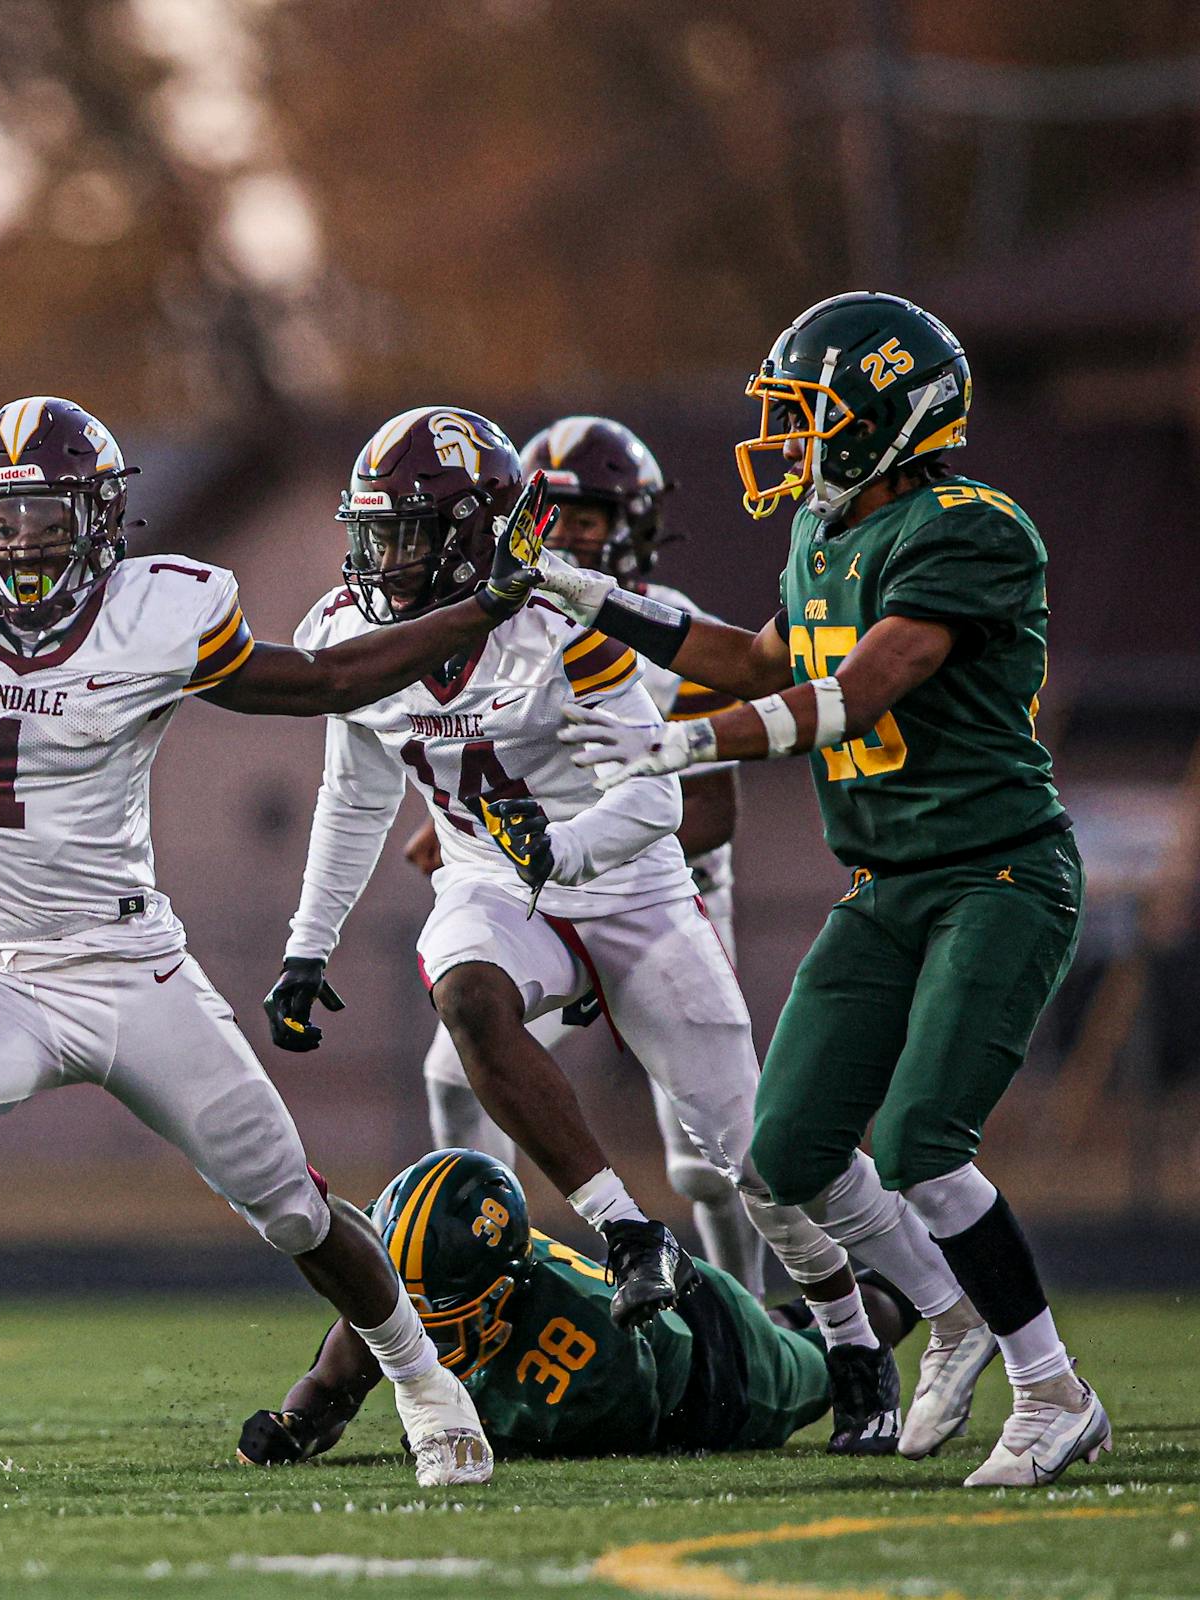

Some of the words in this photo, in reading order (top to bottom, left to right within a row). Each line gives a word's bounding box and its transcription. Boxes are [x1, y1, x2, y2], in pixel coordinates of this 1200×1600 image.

[860, 337, 914, 392] 25
[128, 900, 137, 911] S
[472, 1198, 509, 1247] 38
[516, 1316, 597, 1405] 38
